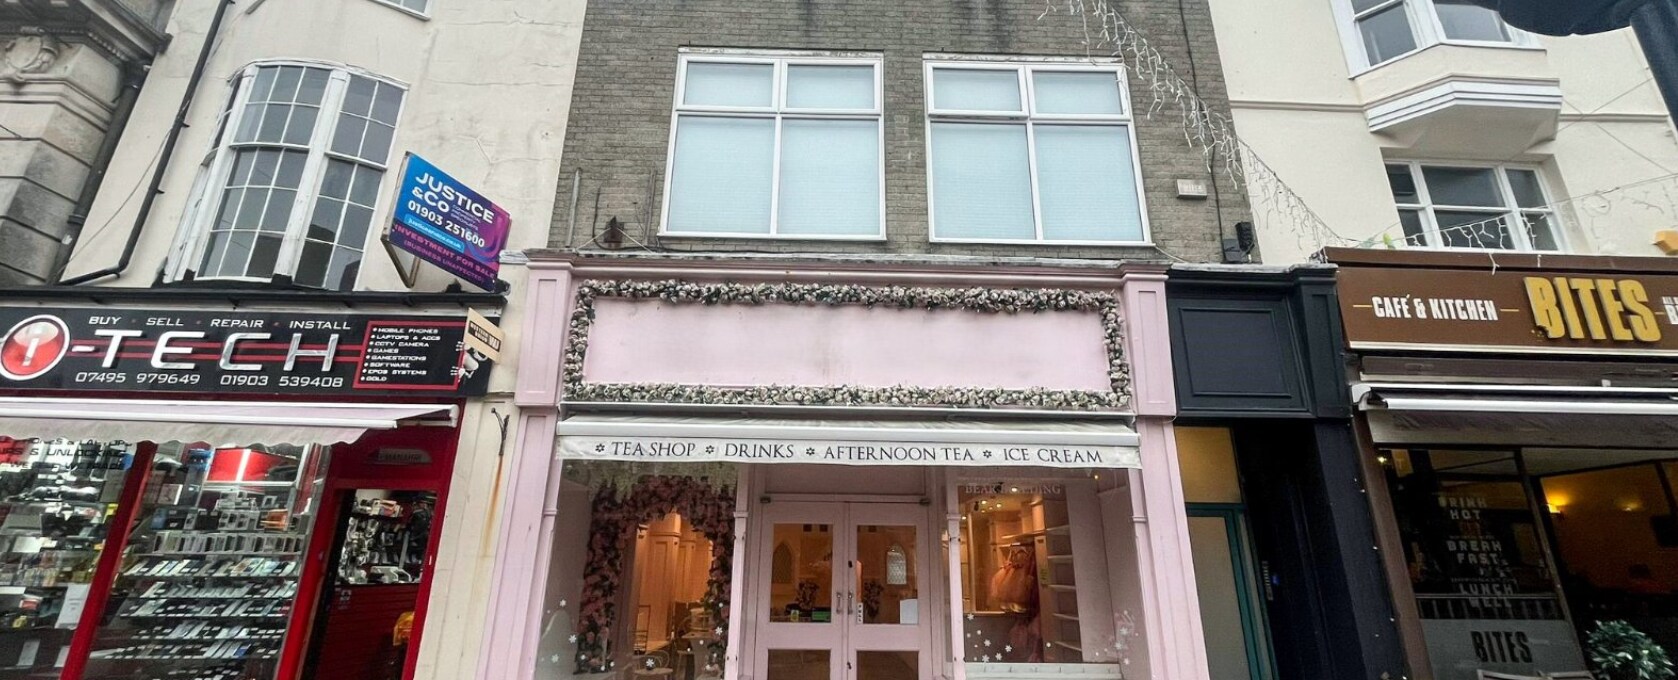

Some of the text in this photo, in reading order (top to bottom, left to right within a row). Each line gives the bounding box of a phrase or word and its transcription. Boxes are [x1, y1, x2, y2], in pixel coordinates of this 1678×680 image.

[415, 172, 495, 224] JUSTICE
[408, 200, 485, 248] 01903 251600
[394, 224, 495, 278] INVESTMENT FOR SALE
[1415, 298, 1427, 319] &
[1428, 298, 1499, 321] KITCHEN
[1523, 276, 1661, 342] BITES
[88, 316, 351, 330] BUY SELL REPAIR INSTALL
[75, 371, 344, 387] 07495 979649 01903 539408
[612, 441, 1103, 464] TEA SHOP DRINKS AFTERNOON TEA ICE CREAM
[1450, 509, 1481, 520] HOT
[1446, 539, 1502, 552] BREAK
[1457, 552, 1498, 565] FAST
[1459, 583, 1514, 597] LUNCH
[1470, 631, 1533, 663] BITES
